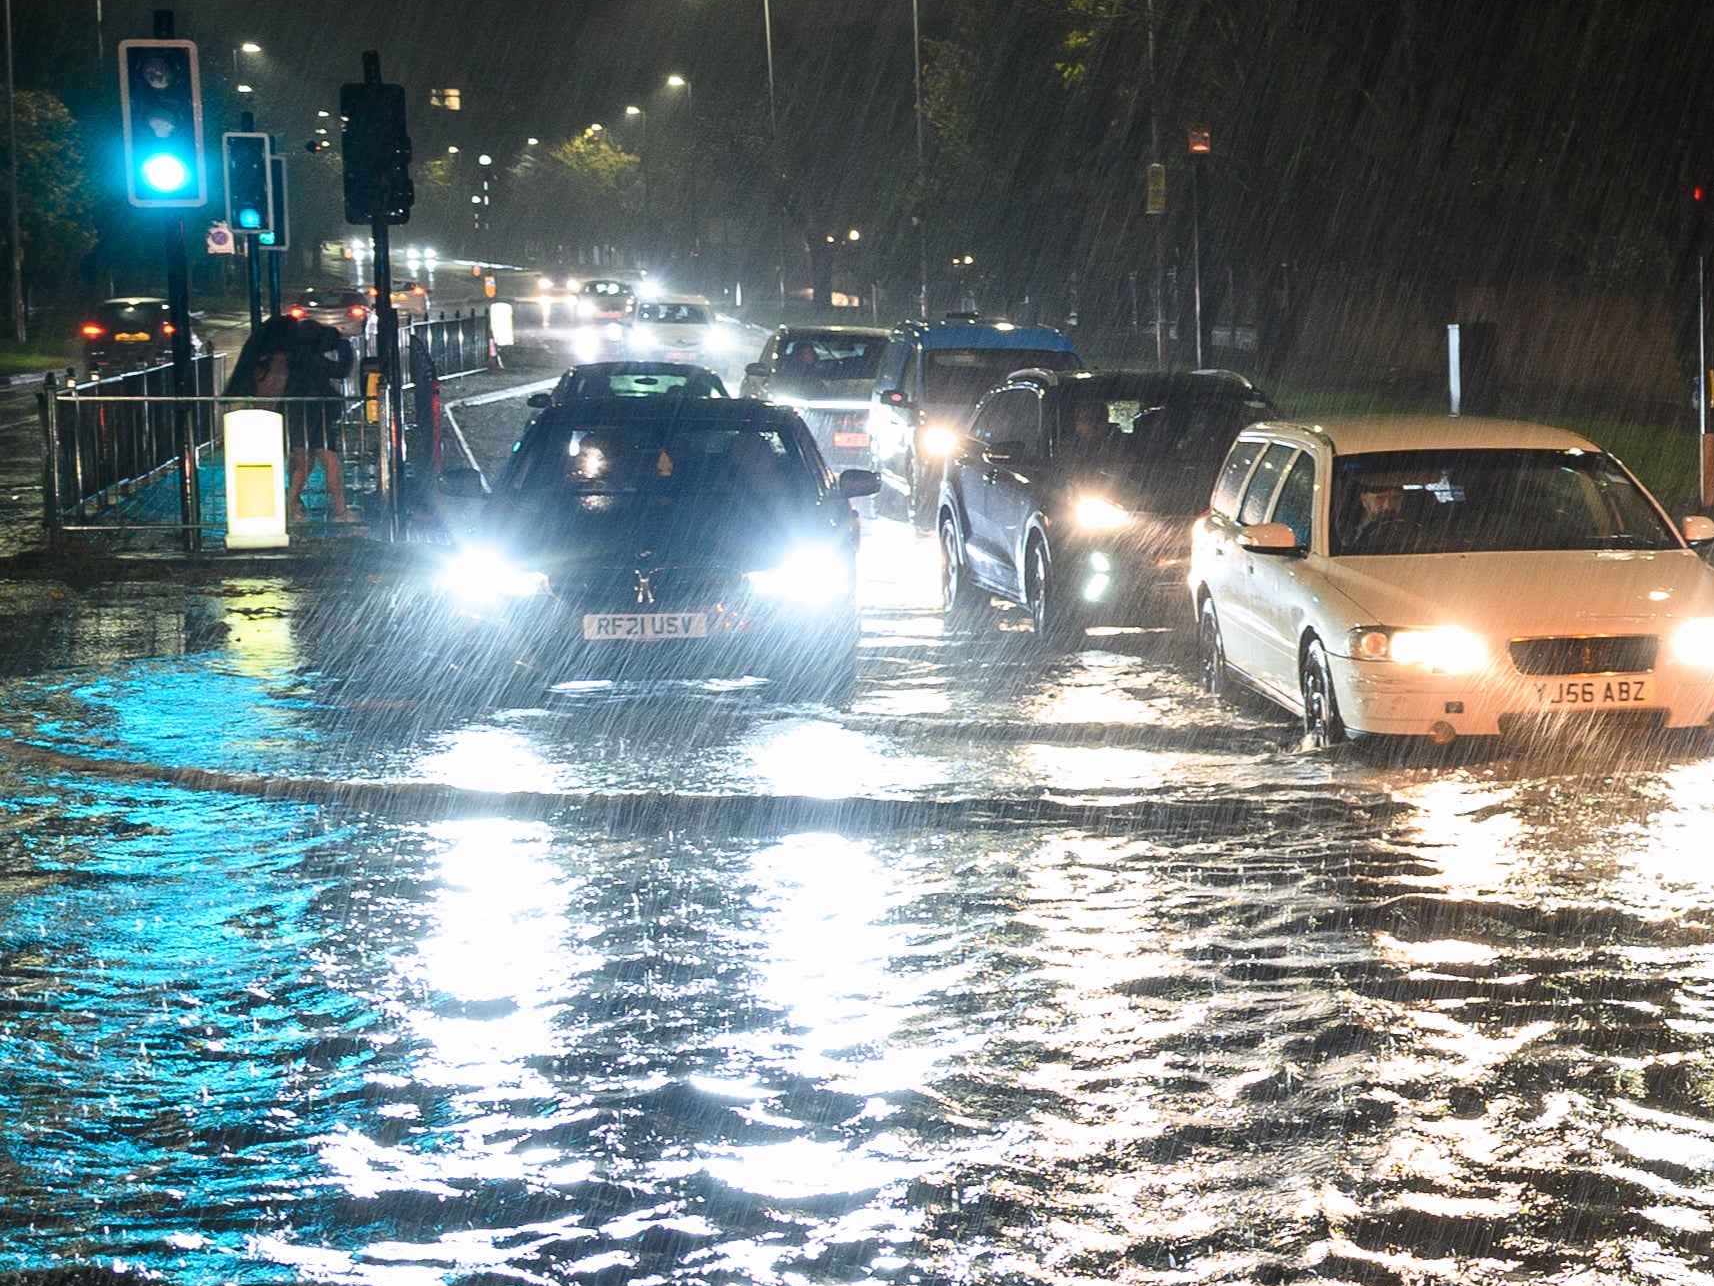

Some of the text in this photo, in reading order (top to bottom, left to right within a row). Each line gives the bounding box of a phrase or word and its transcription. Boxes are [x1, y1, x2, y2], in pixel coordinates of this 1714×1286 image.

[596, 616, 692, 635] RF21 USV
[1534, 681, 1645, 704] YJ56 ABZ
